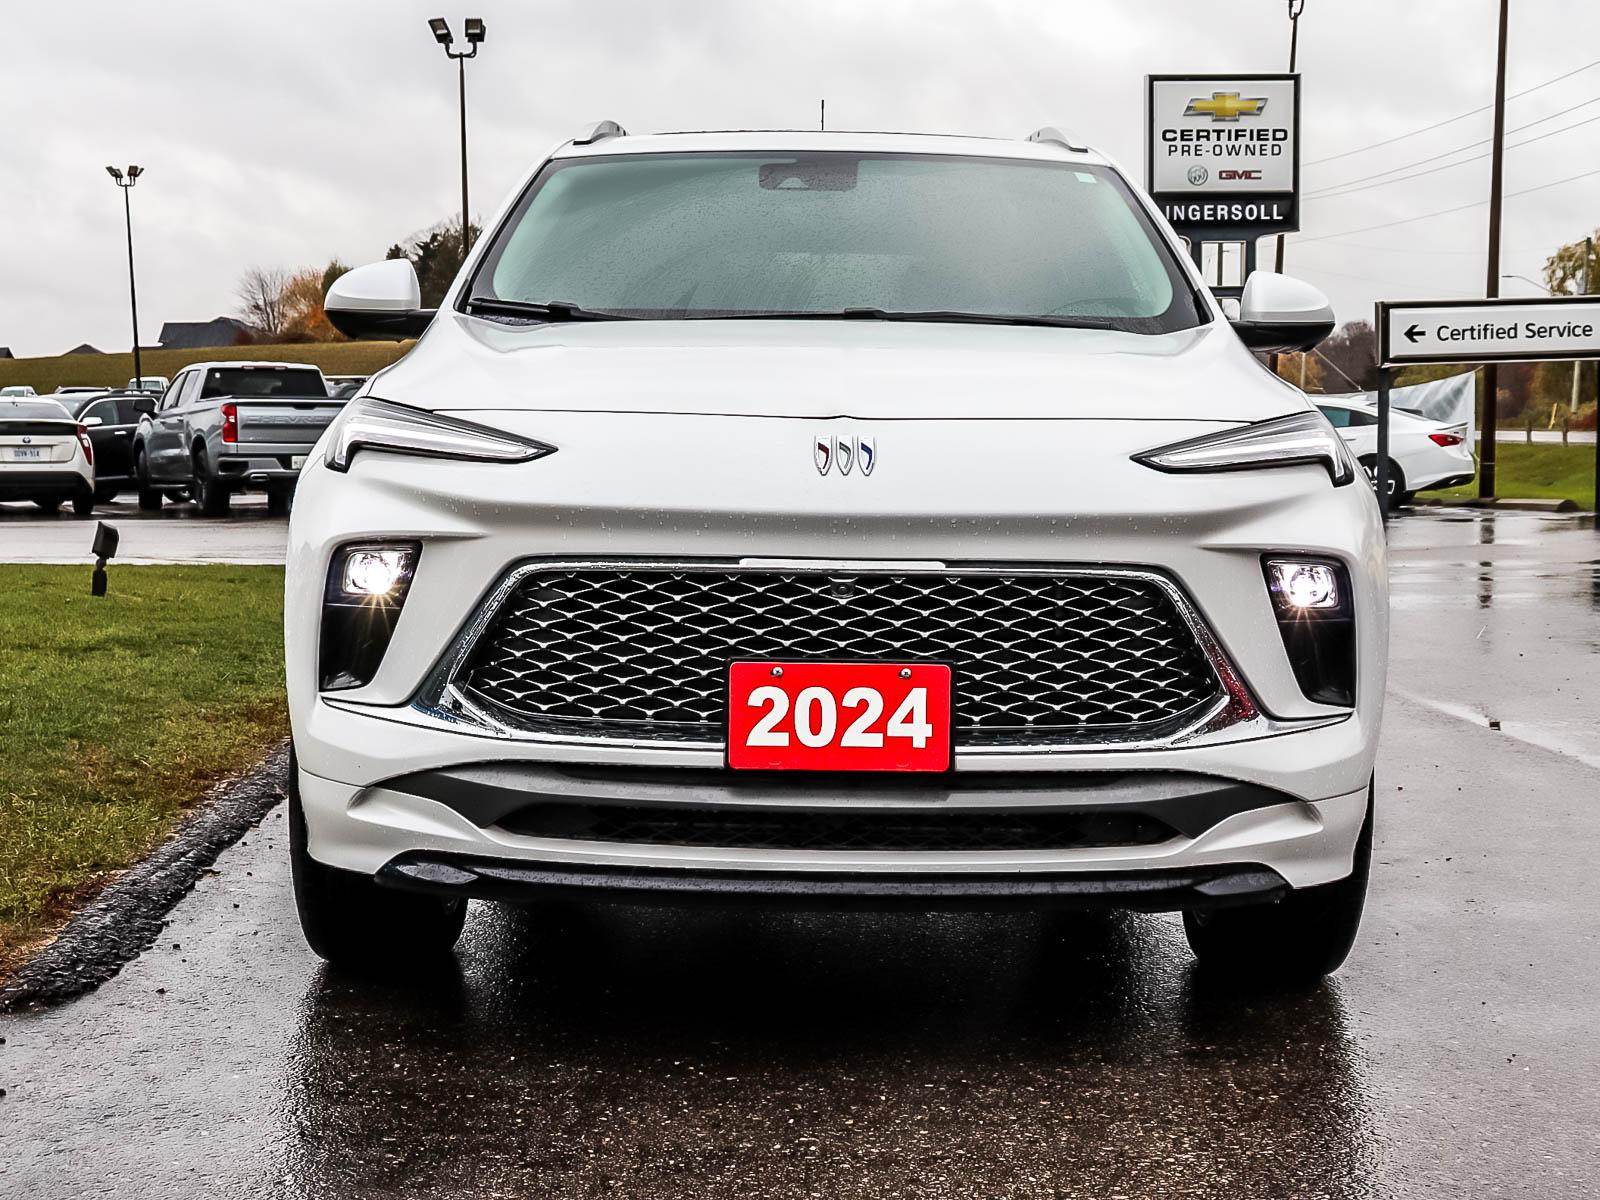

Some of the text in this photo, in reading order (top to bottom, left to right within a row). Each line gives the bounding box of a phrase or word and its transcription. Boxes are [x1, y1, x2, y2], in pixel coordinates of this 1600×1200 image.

[1161, 129, 1288, 142] CERTIFIED
[1168, 144, 1282, 156] PRE-OWNED
[1218, 169, 1262, 180] GMC
[1165, 204, 1283, 221] INGERSOLL
[1436, 321, 1593, 341] Certified Service
[746, 686, 933, 748] 2024
